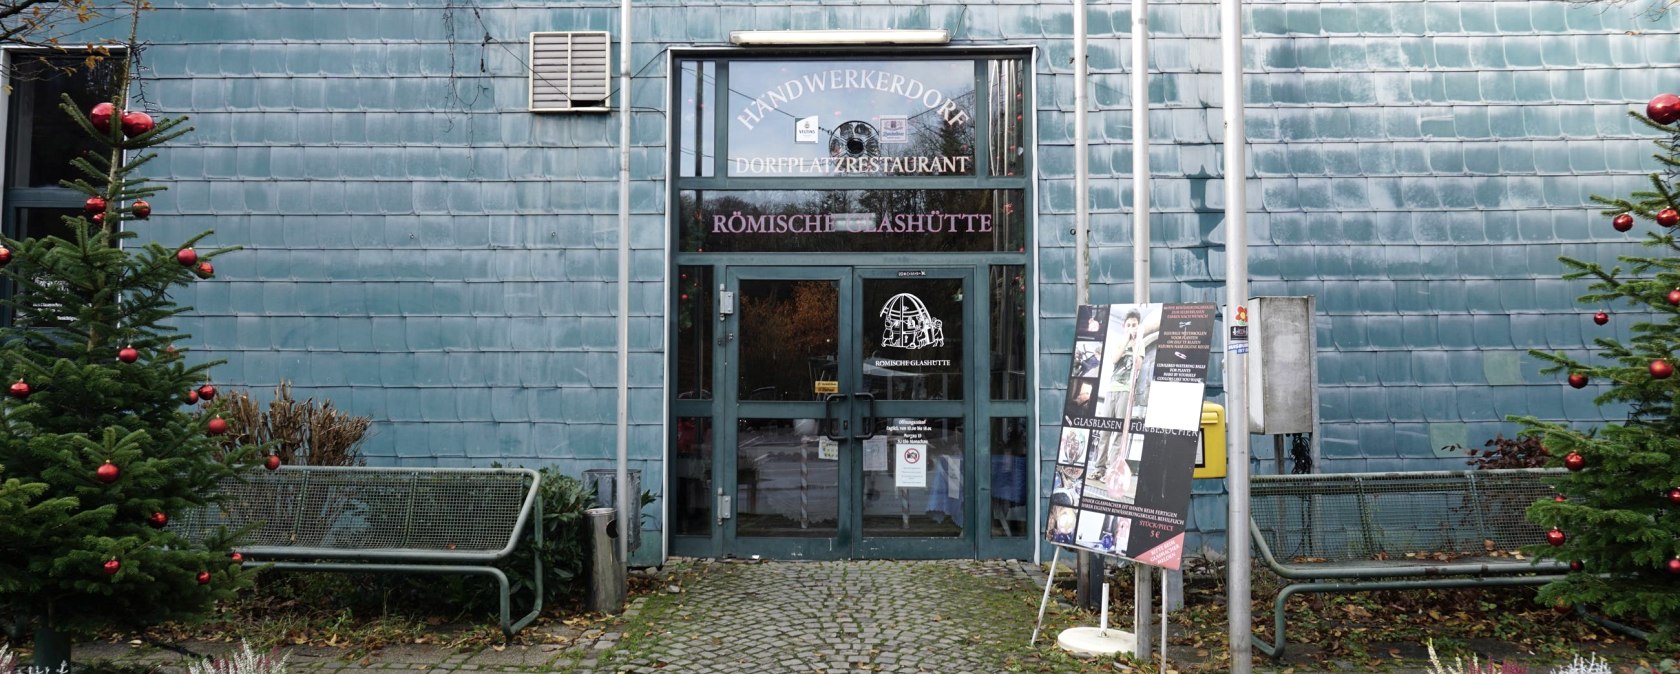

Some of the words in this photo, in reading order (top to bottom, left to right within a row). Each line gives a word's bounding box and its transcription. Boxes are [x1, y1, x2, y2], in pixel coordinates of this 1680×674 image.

[736, 156, 970, 174] DORFPLATZRESTAURANT
[712, 211, 836, 234] RÖMISCHE
[845, 211, 992, 234] GLASHÜTTE
[1074, 418, 1122, 430] GLASBLASEN
[1155, 509, 1177, 518] FERTIGEN
[1139, 520, 1174, 531] STÜCK/PIECE
